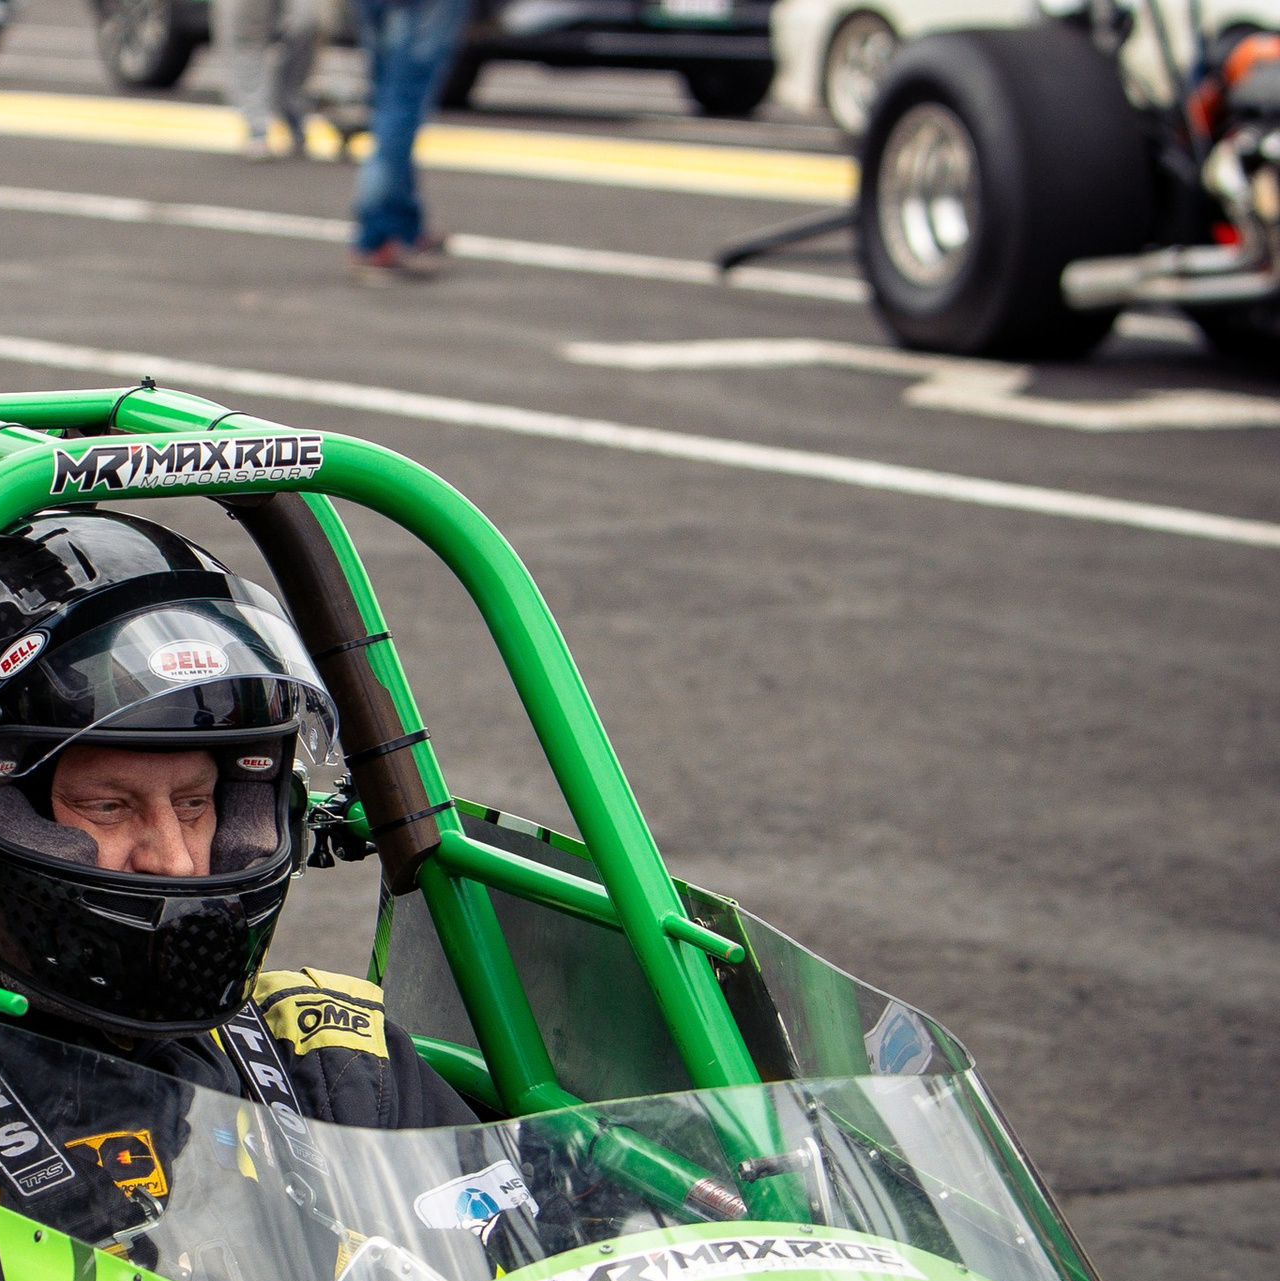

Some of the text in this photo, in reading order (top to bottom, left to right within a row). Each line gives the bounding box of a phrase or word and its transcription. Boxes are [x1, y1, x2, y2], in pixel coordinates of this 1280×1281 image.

[140, 465, 320, 489] MOTORSPORT
[0, 639, 38, 674] BELL
[161, 650, 220, 671] BELL
[242, 758, 269, 766] BELL
[297, 1005, 370, 1034] OMP
[227, 1024, 306, 1135] TRS
[19, 1161, 64, 1188] TRS
